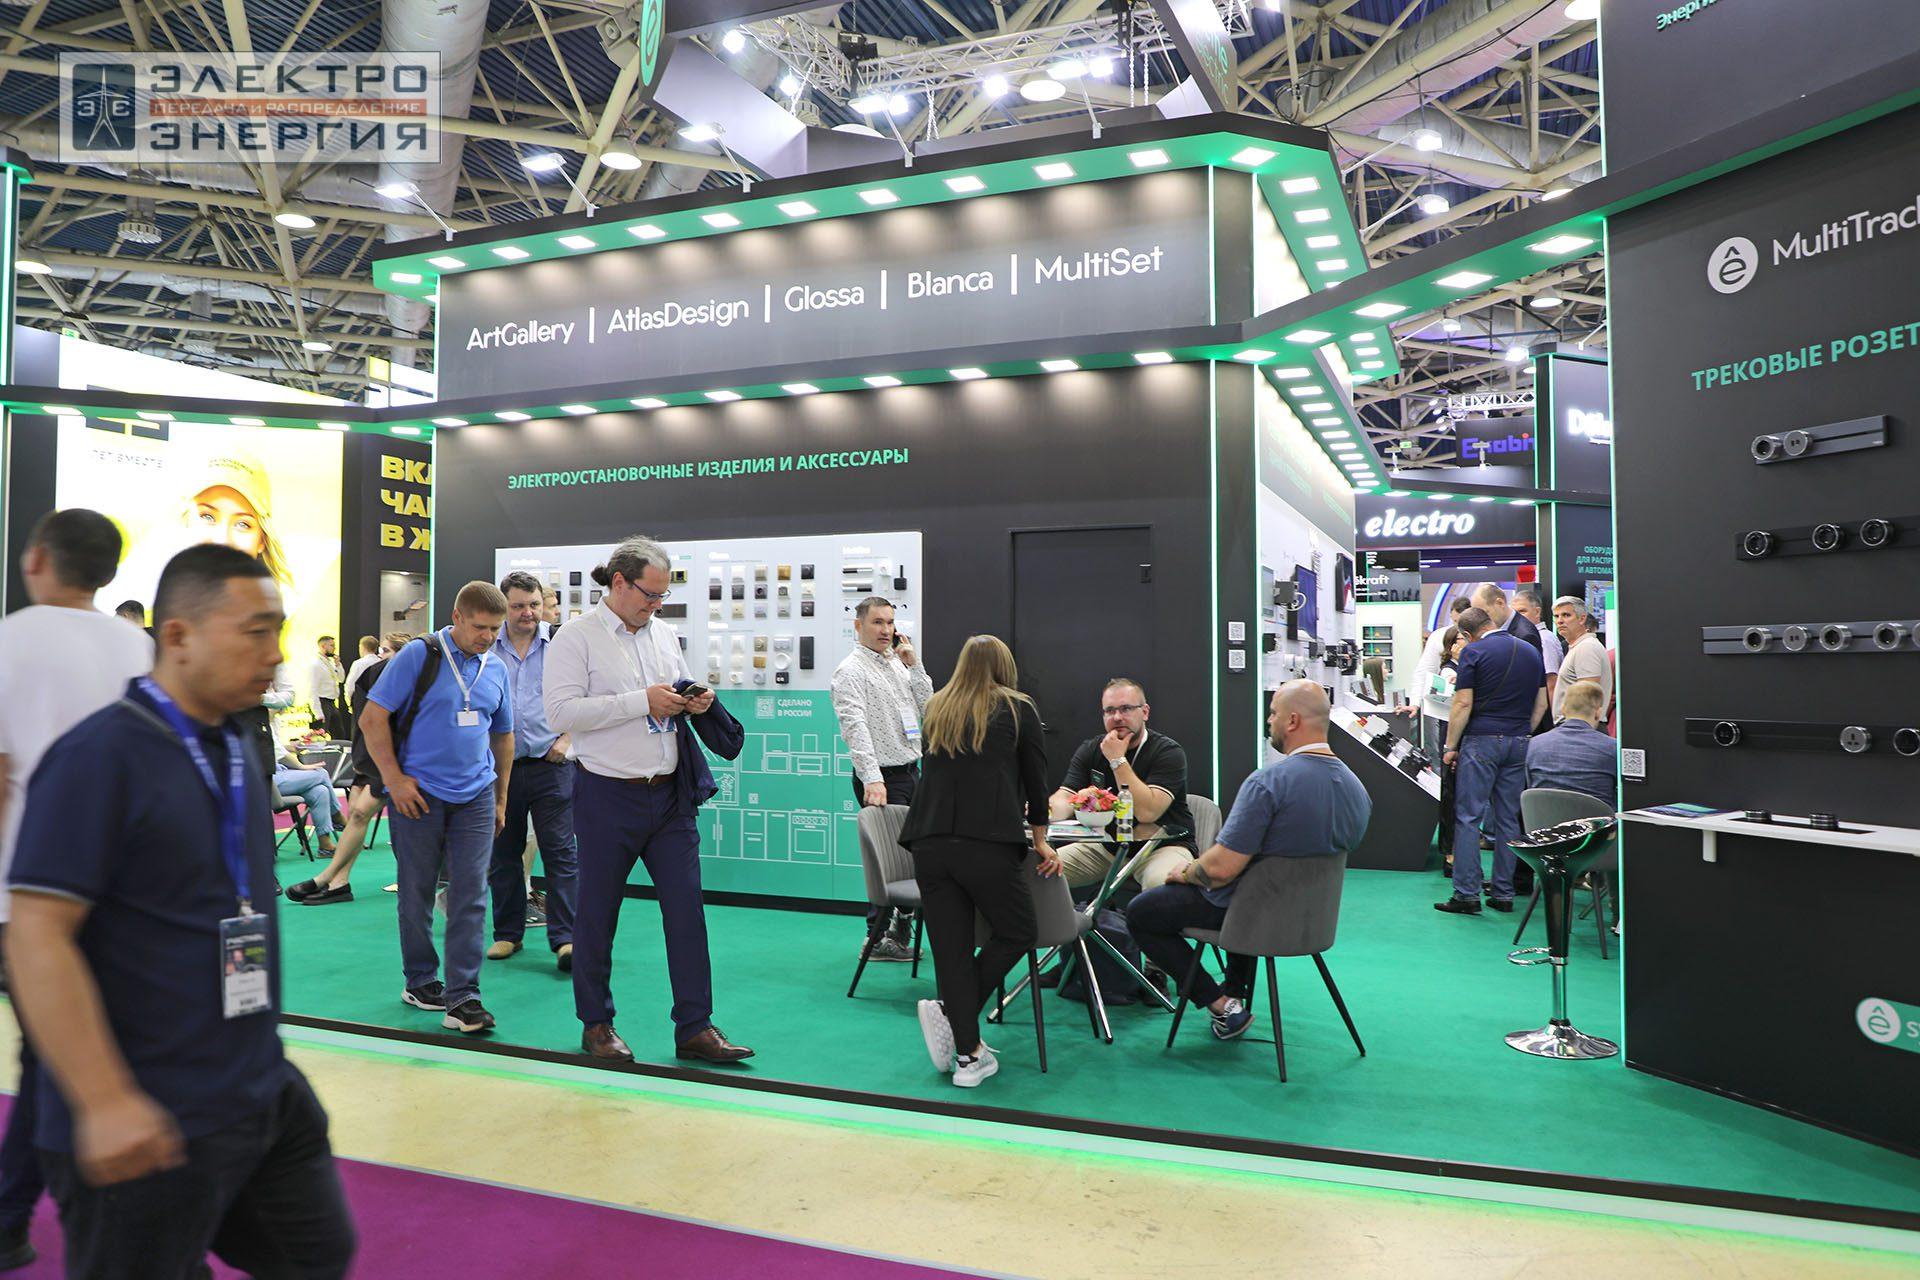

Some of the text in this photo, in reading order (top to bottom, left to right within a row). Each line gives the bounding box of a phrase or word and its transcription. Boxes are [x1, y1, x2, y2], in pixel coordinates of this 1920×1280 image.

[466, 245, 1164, 351] ArtGallery AtlasDesign Glossa Blanca MultiSet
[1691, 344, 1823, 391] ТРЕКОВЫЕ
[508, 448, 909, 490] ЭЛЕКТРОУСТАНОВОЧНЫЕ ИЗДЕЛИЯ И АКСЕССУАРЫ
[381, 488, 432, 518] ЧА
[381, 523, 405, 548] В
[1364, 508, 1475, 537] electro
[777, 699, 812, 708] СДЕЛАНО
